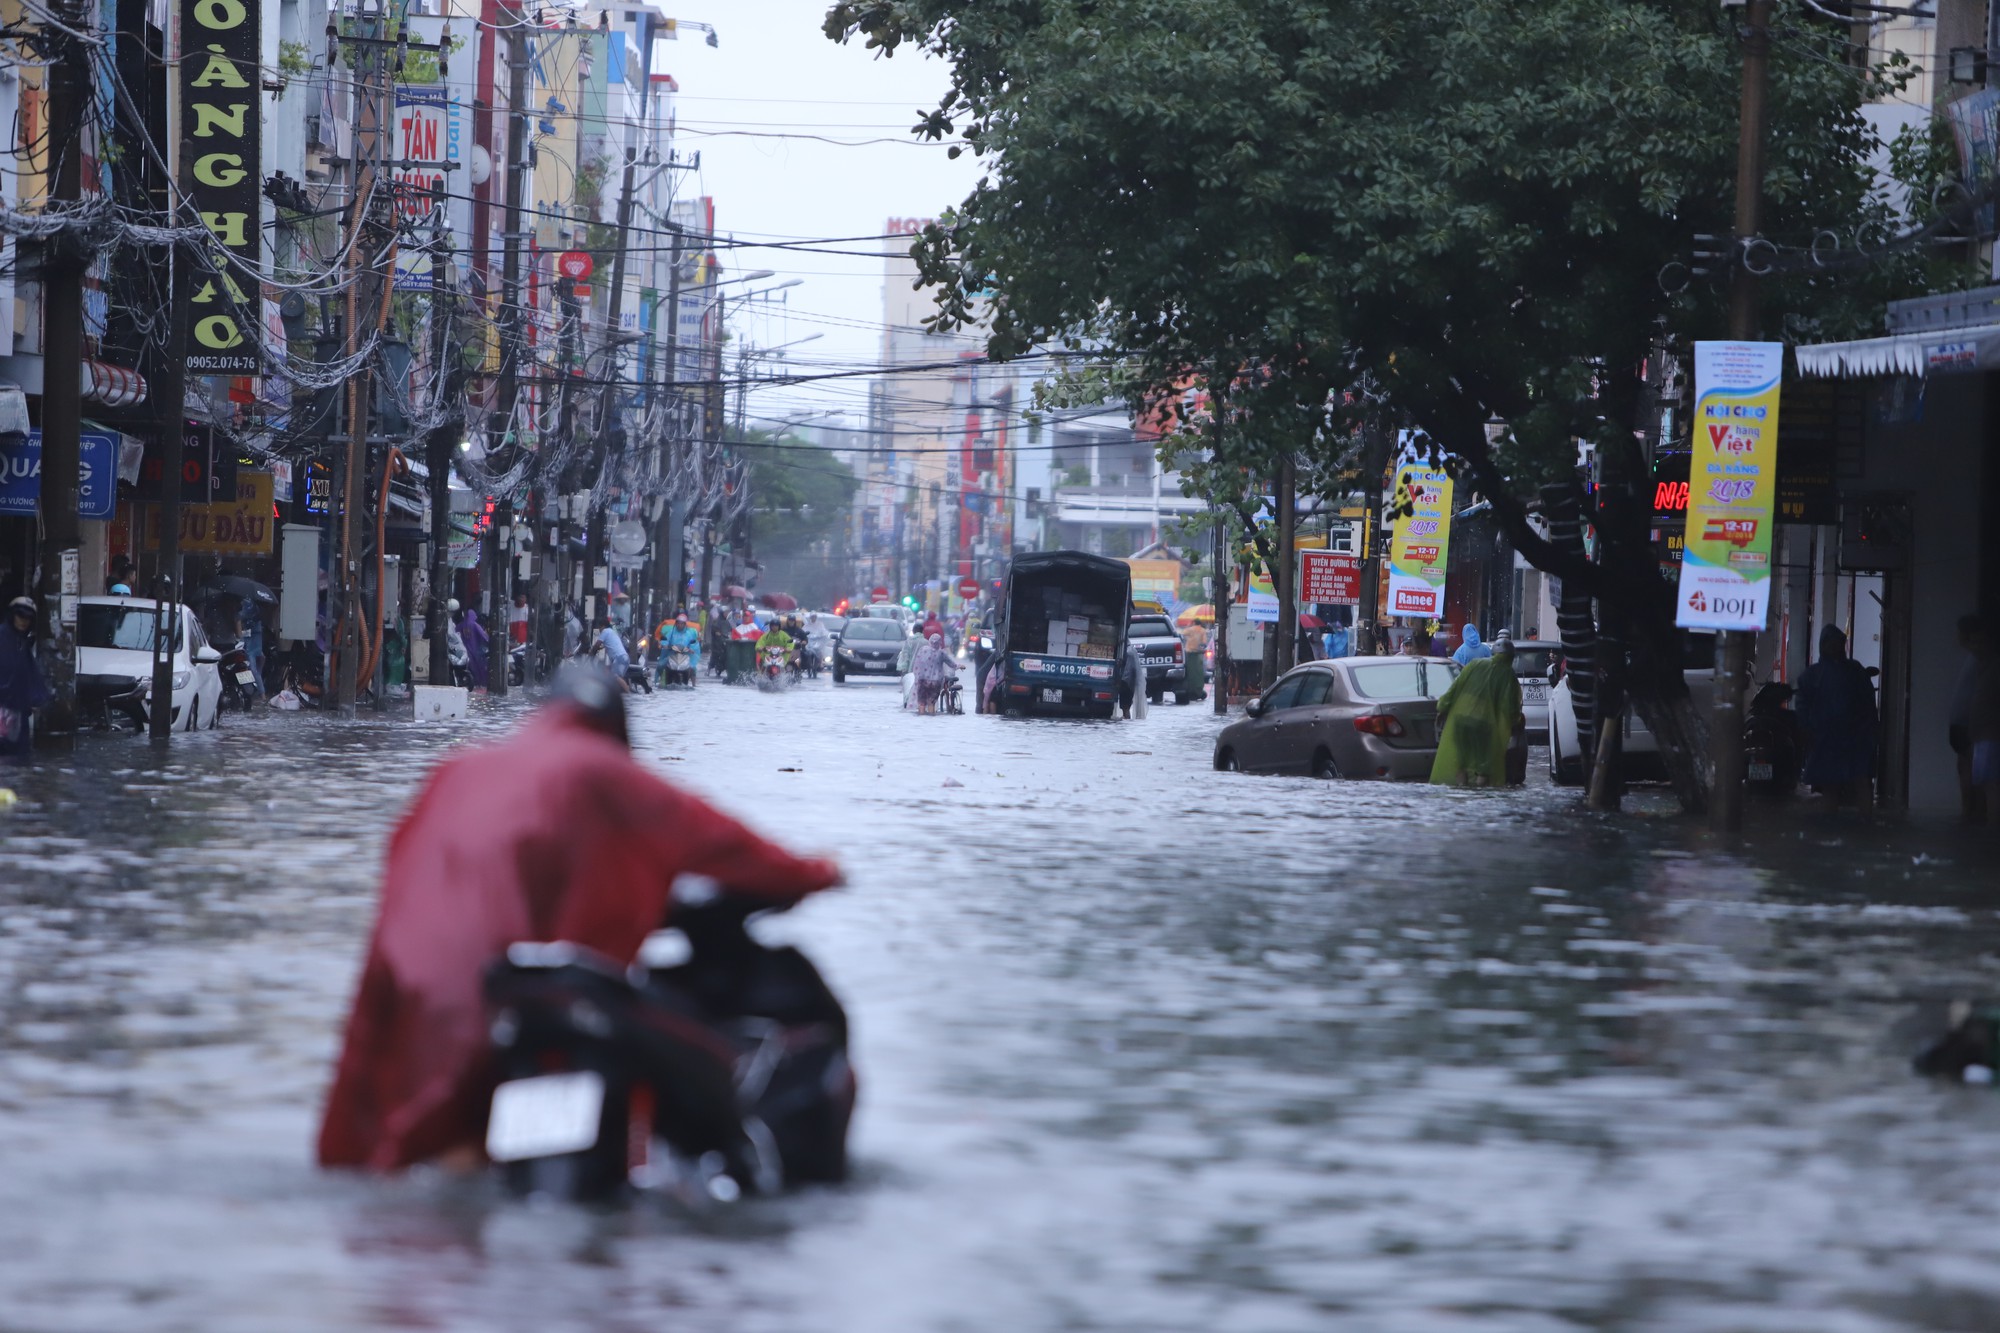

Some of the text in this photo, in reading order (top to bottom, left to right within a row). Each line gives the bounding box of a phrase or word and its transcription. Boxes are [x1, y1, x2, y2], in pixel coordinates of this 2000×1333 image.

[402, 110, 437, 161] TÂN
[186, 356, 255, 369] 09052.074-76
[1707, 425, 1753, 455] Việt
[1407, 485, 1438, 505] Việt
[1707, 479, 1755, 503] 2018
[8, 497, 35, 506] VƯƠNG
[1407, 520, 1438, 536] 2018
[1725, 521, 1753, 531] 12-17
[1418, 547, 1437, 555] 12-17
[1398, 592, 1433, 606] Ranee
[1712, 597, 1756, 619] DOJI
